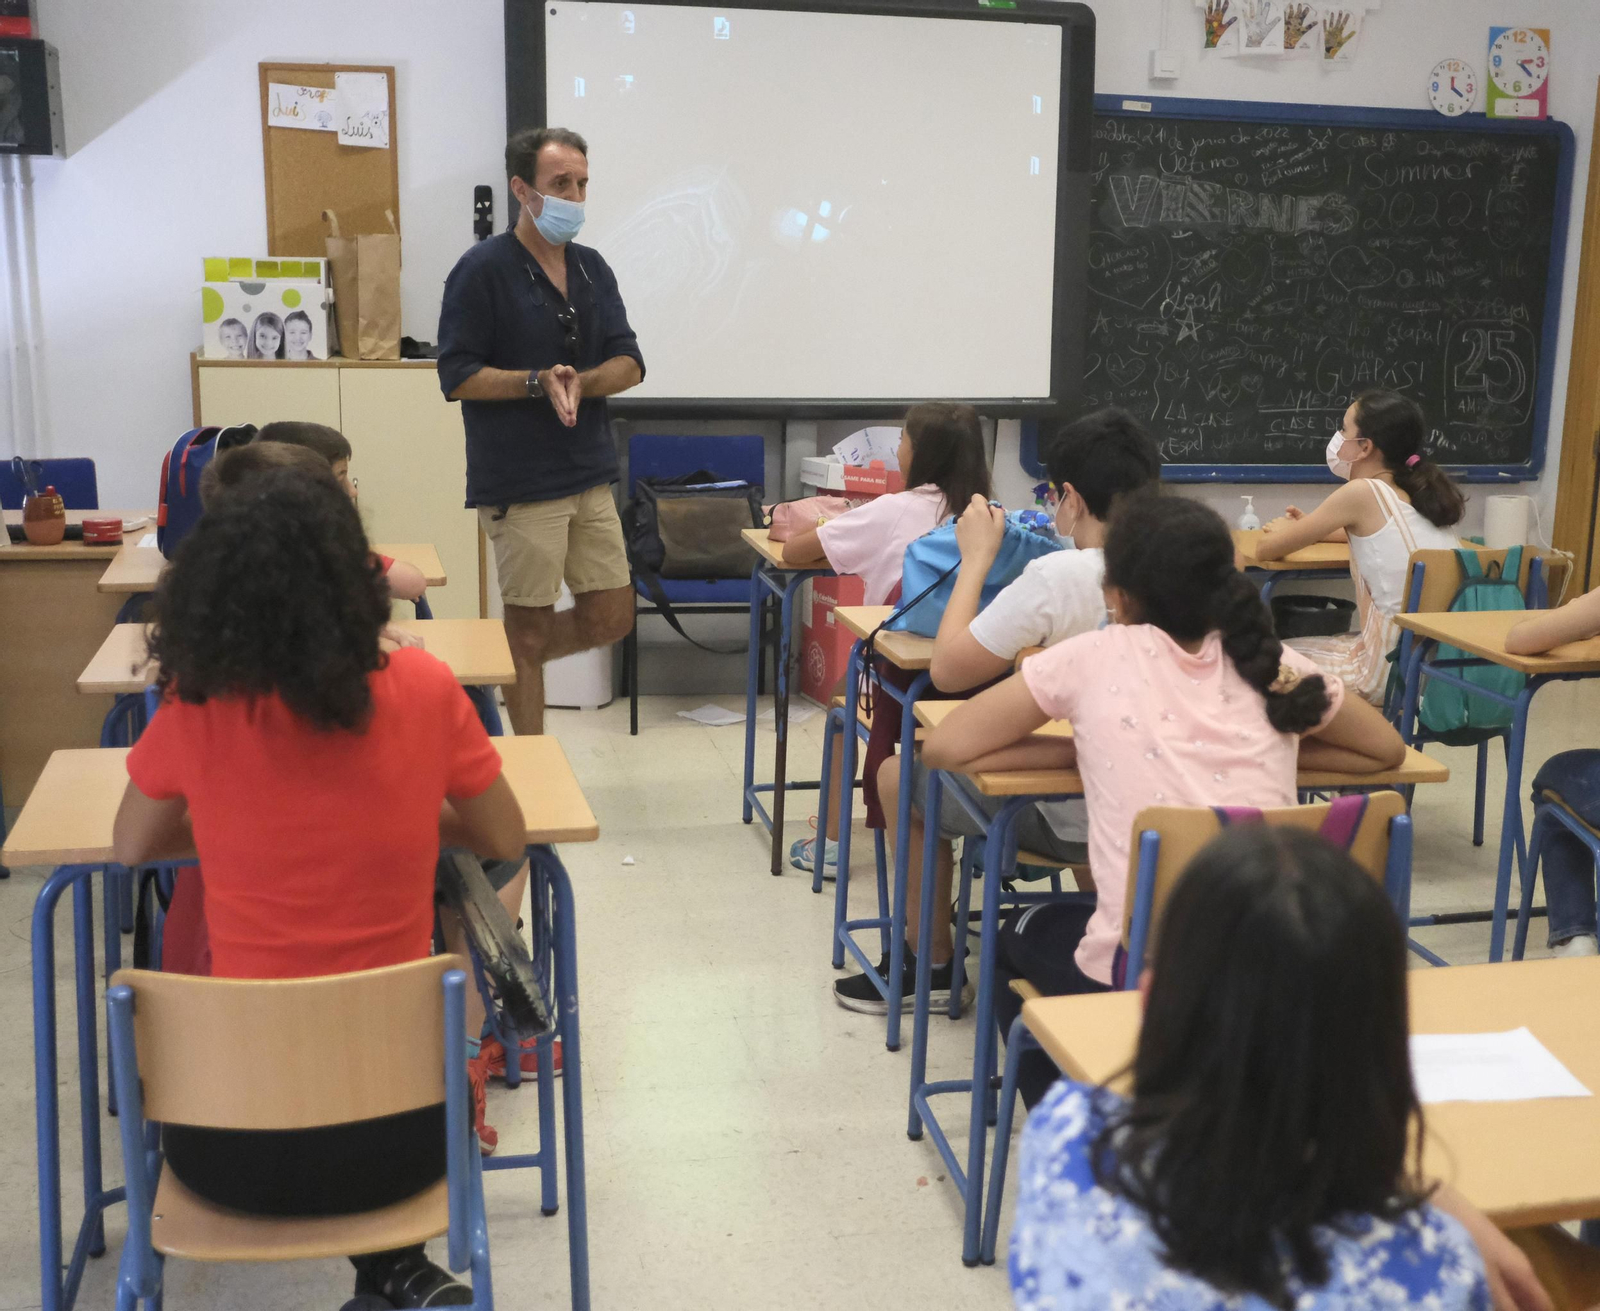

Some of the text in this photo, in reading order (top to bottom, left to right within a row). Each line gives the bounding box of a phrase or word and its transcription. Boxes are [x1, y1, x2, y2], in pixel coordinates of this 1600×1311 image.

[1512, 31, 1527, 43] 12
[1447, 61, 1460, 72] 12
[1493, 55, 1502, 67] 9
[1535, 56, 1545, 68] 3
[1432, 82, 1439, 92] 9
[1466, 83, 1473, 93] 3
[1513, 81, 1521, 92] 6
[272, 92, 306, 121] Luis
[1447, 103, 1455, 113] 6
[341, 116, 373, 139] Luis
[1254, 125, 1290, 141] 2022
[1108, 173, 1360, 239] VIERNES
[1453, 326, 1527, 404] 25
[1192, 411, 1236, 428] CLASE
[1270, 416, 1316, 432] CLASE
